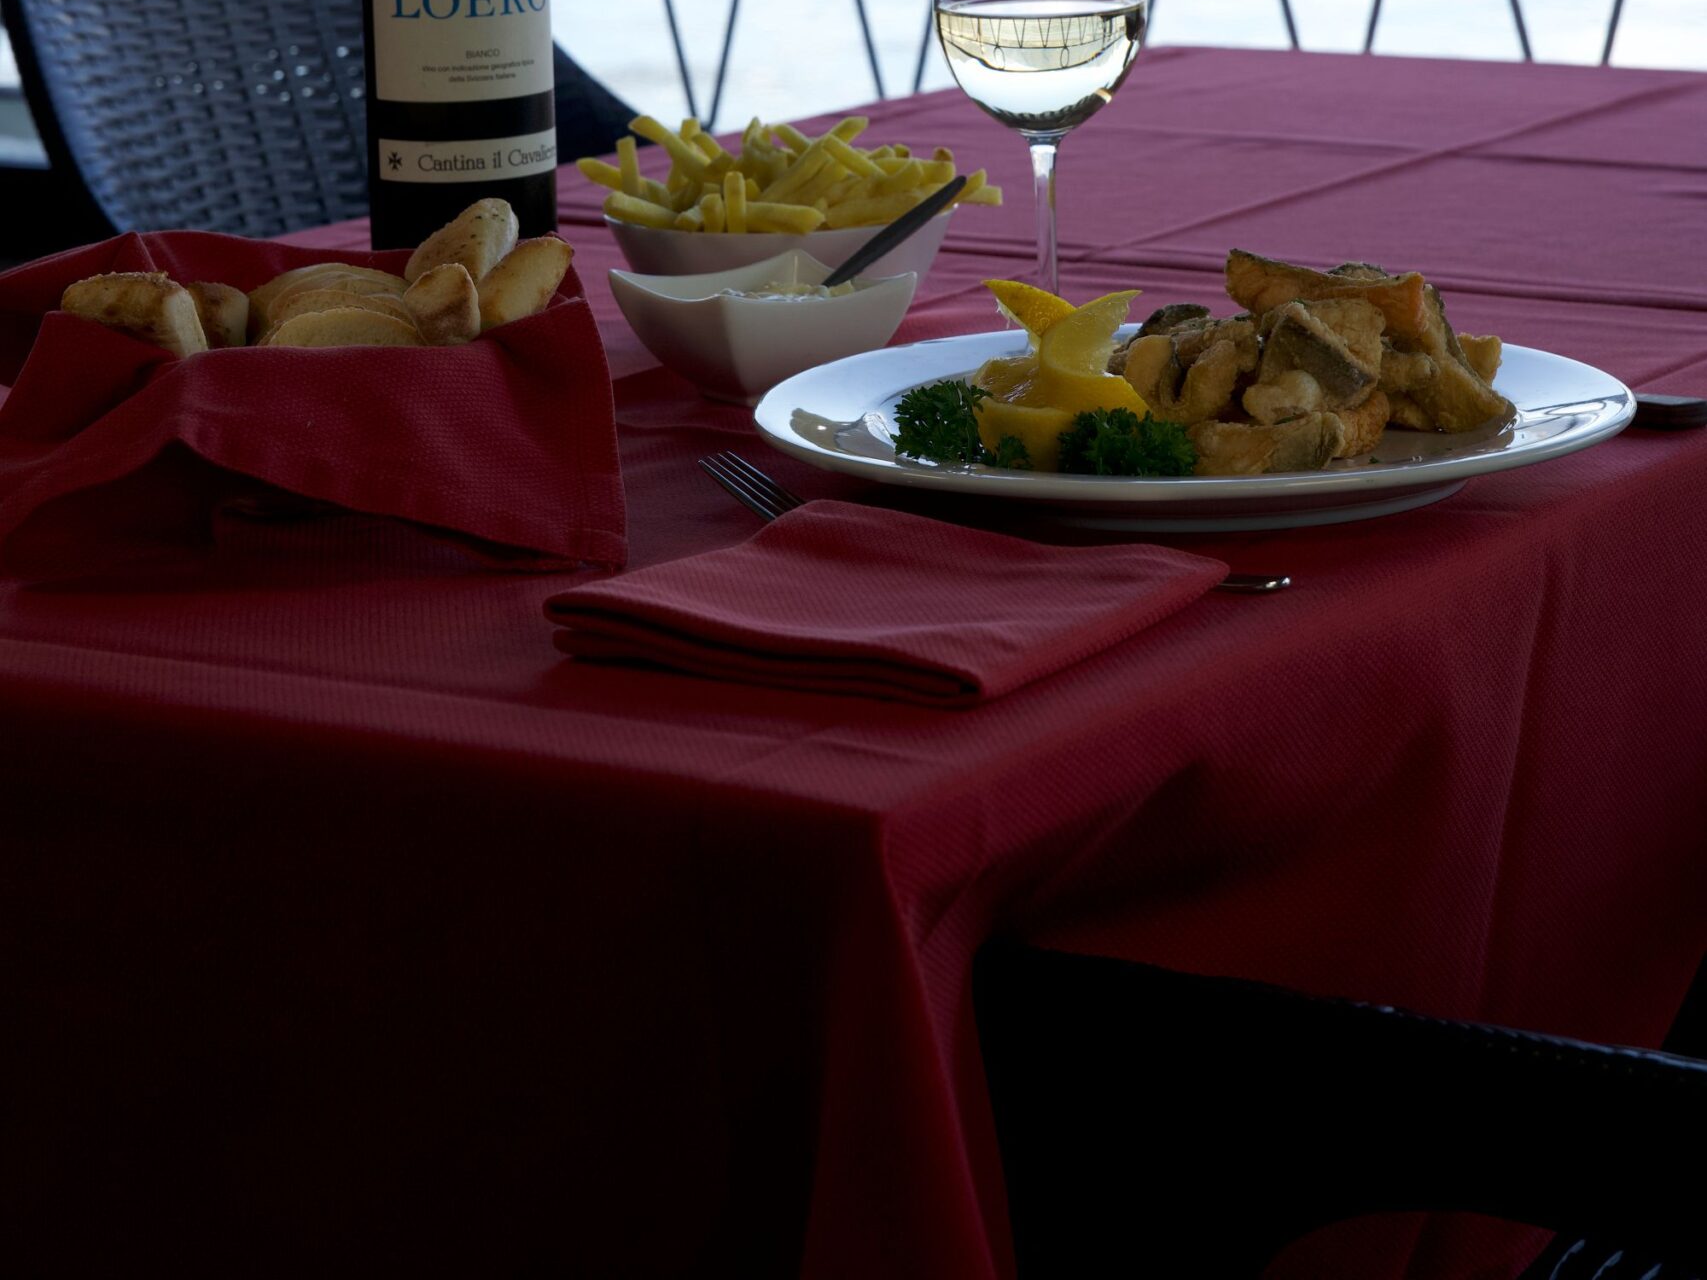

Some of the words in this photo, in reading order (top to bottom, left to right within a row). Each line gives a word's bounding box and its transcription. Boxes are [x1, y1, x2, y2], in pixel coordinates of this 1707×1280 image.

[465, 48, 500, 59] BIANCO
[418, 154, 486, 171] Cantina
[493, 150, 503, 169] il
